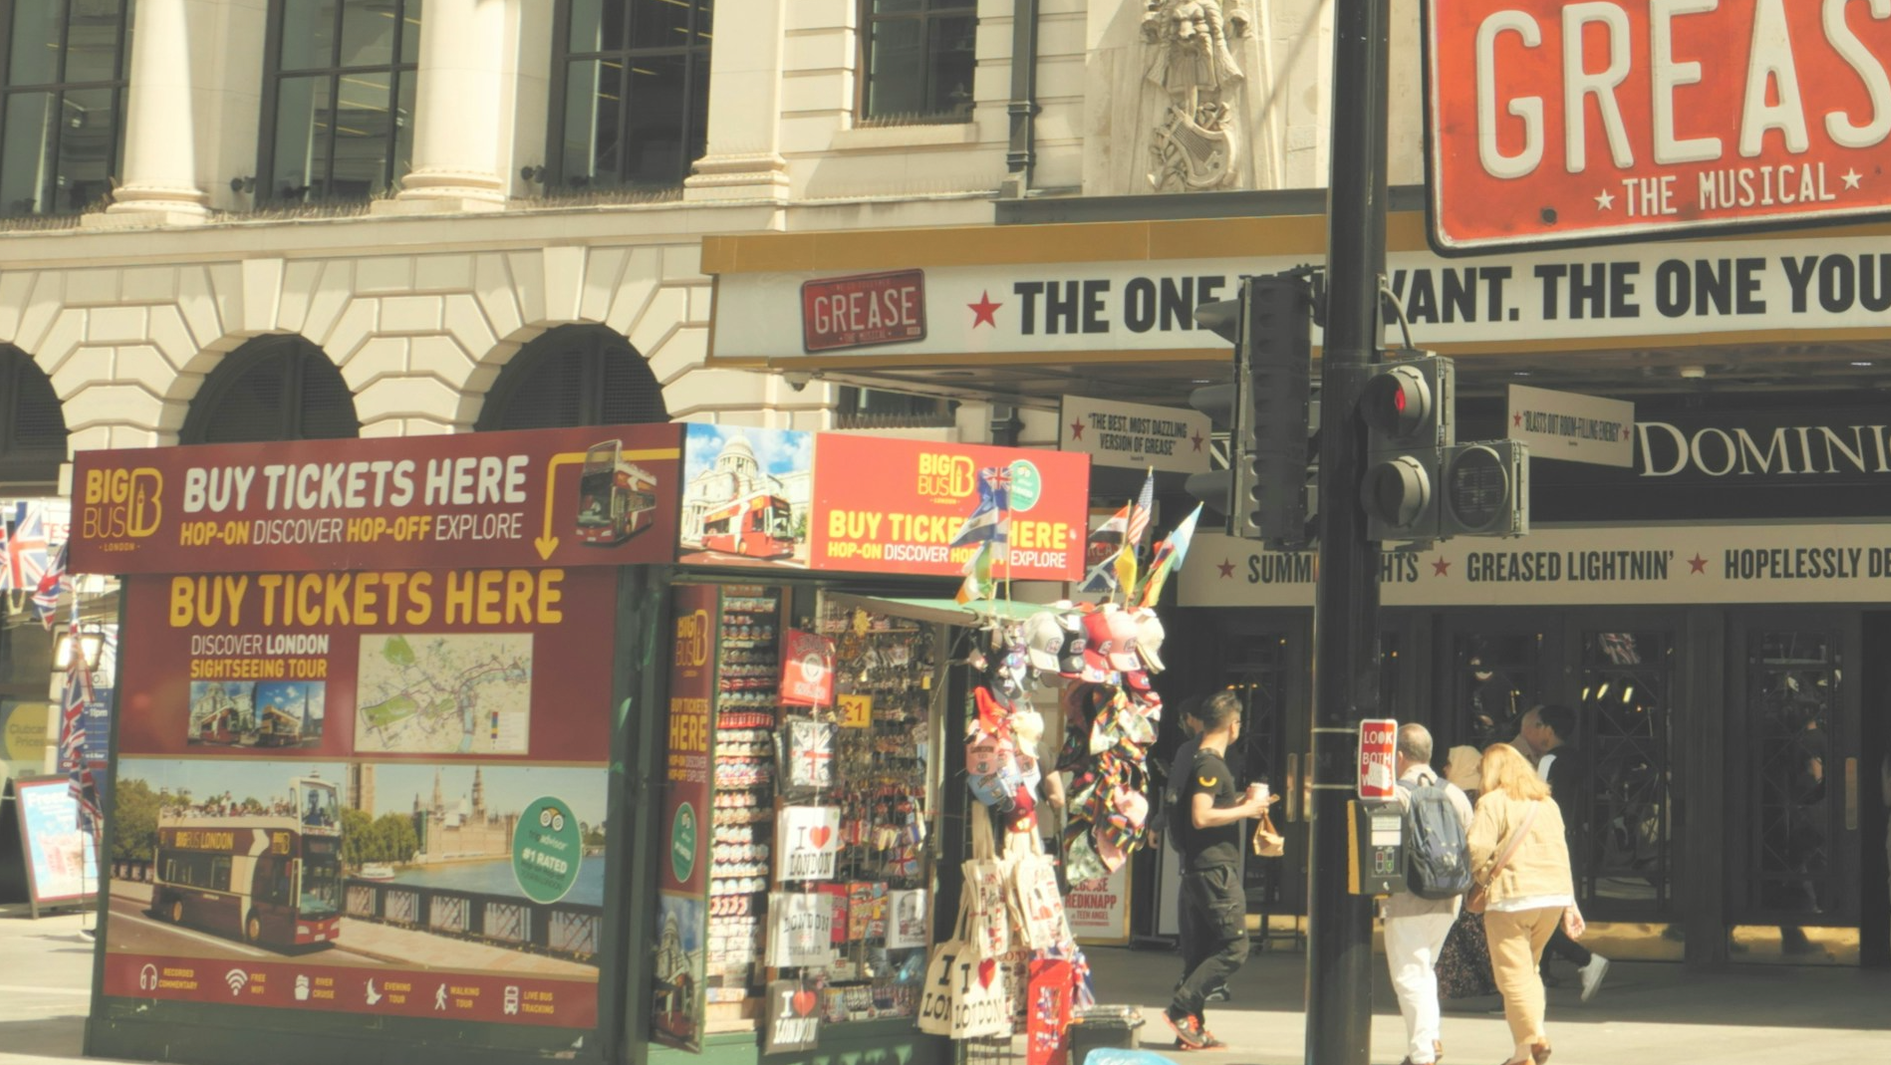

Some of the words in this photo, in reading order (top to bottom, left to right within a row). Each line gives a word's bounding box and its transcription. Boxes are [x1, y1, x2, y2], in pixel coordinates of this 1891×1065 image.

[1623, 175, 1677, 217] THE
[1699, 161, 1836, 211] MUSICAL
[1013, 280, 1110, 335] THE
[1534, 262, 1641, 320] THE
[1655, 257, 1767, 318] ONE
[814, 286, 917, 334] GREASE
[1130, 417, 1152, 434] MOST
[1152, 419, 1187, 439] DAZZLING
[1100, 435, 1133, 452] VERSION
[1134, 438, 1143, 453] OF
[919, 453, 950, 476] BIG
[85, 468, 128, 504] BIG
[183, 466, 255, 512] BUY
[263, 460, 416, 511] TICKETS
[424, 455, 529, 506] HERE
[918, 476, 949, 495] BUS
[83, 506, 126, 538] BUS
[180, 521, 250, 546] HOP-ON
[252, 518, 344, 545] DISCOVER
[346, 515, 432, 542] HOP-OFF
[435, 512, 524, 541] EXPLORE
[829, 510, 882, 540] BUY
[888, 513, 971, 547] TICKE
[104, 542, 135, 552] LONDON
[828, 541, 882, 559] HOP-ON
[884, 544, 949, 563] DISCOVER
[1010, 551, 1066, 568] EXPLORE
[1248, 553, 1315, 584] SUMM
[1467, 551, 1562, 583] GREASED
[1724, 546, 1862, 580] HOPELESSLY
[170, 575, 248, 627] BUY
[258, 571, 433, 626] TICKETS
[445, 569, 565, 624] HERE
[191, 635, 262, 655] DISCOVER
[266, 634, 329, 655] LONDON
[190, 658, 284, 678] SIGHTSEEING
[288, 658, 327, 678] TOUR
[671, 698, 684, 712] BUY
[686, 697, 708, 713] TICKETS
[669, 714, 708, 752] HERE
[1363, 731, 1393, 744] LOOK
[1362, 752, 1392, 765] BOTH
[537, 852, 567, 874] RATED
[789, 853, 832, 878] LONDON
[1065, 894, 1117, 909] REDKNAPP
[251, 973, 266, 983] FREE
[315, 977, 333, 987] RIVER
[384, 981, 411, 993] EVENING
[389, 994, 405, 1004] TOUR
[450, 986, 480, 997] WALKING
[523, 990, 538, 1001] LIVE
[539, 991, 553, 1002] BUS
[455, 998, 473, 1009] TOUR
[521, 1002, 554, 1014] TRACKING
[955, 998, 1002, 1030] LONDON
[773, 1017, 819, 1045] LONDON
